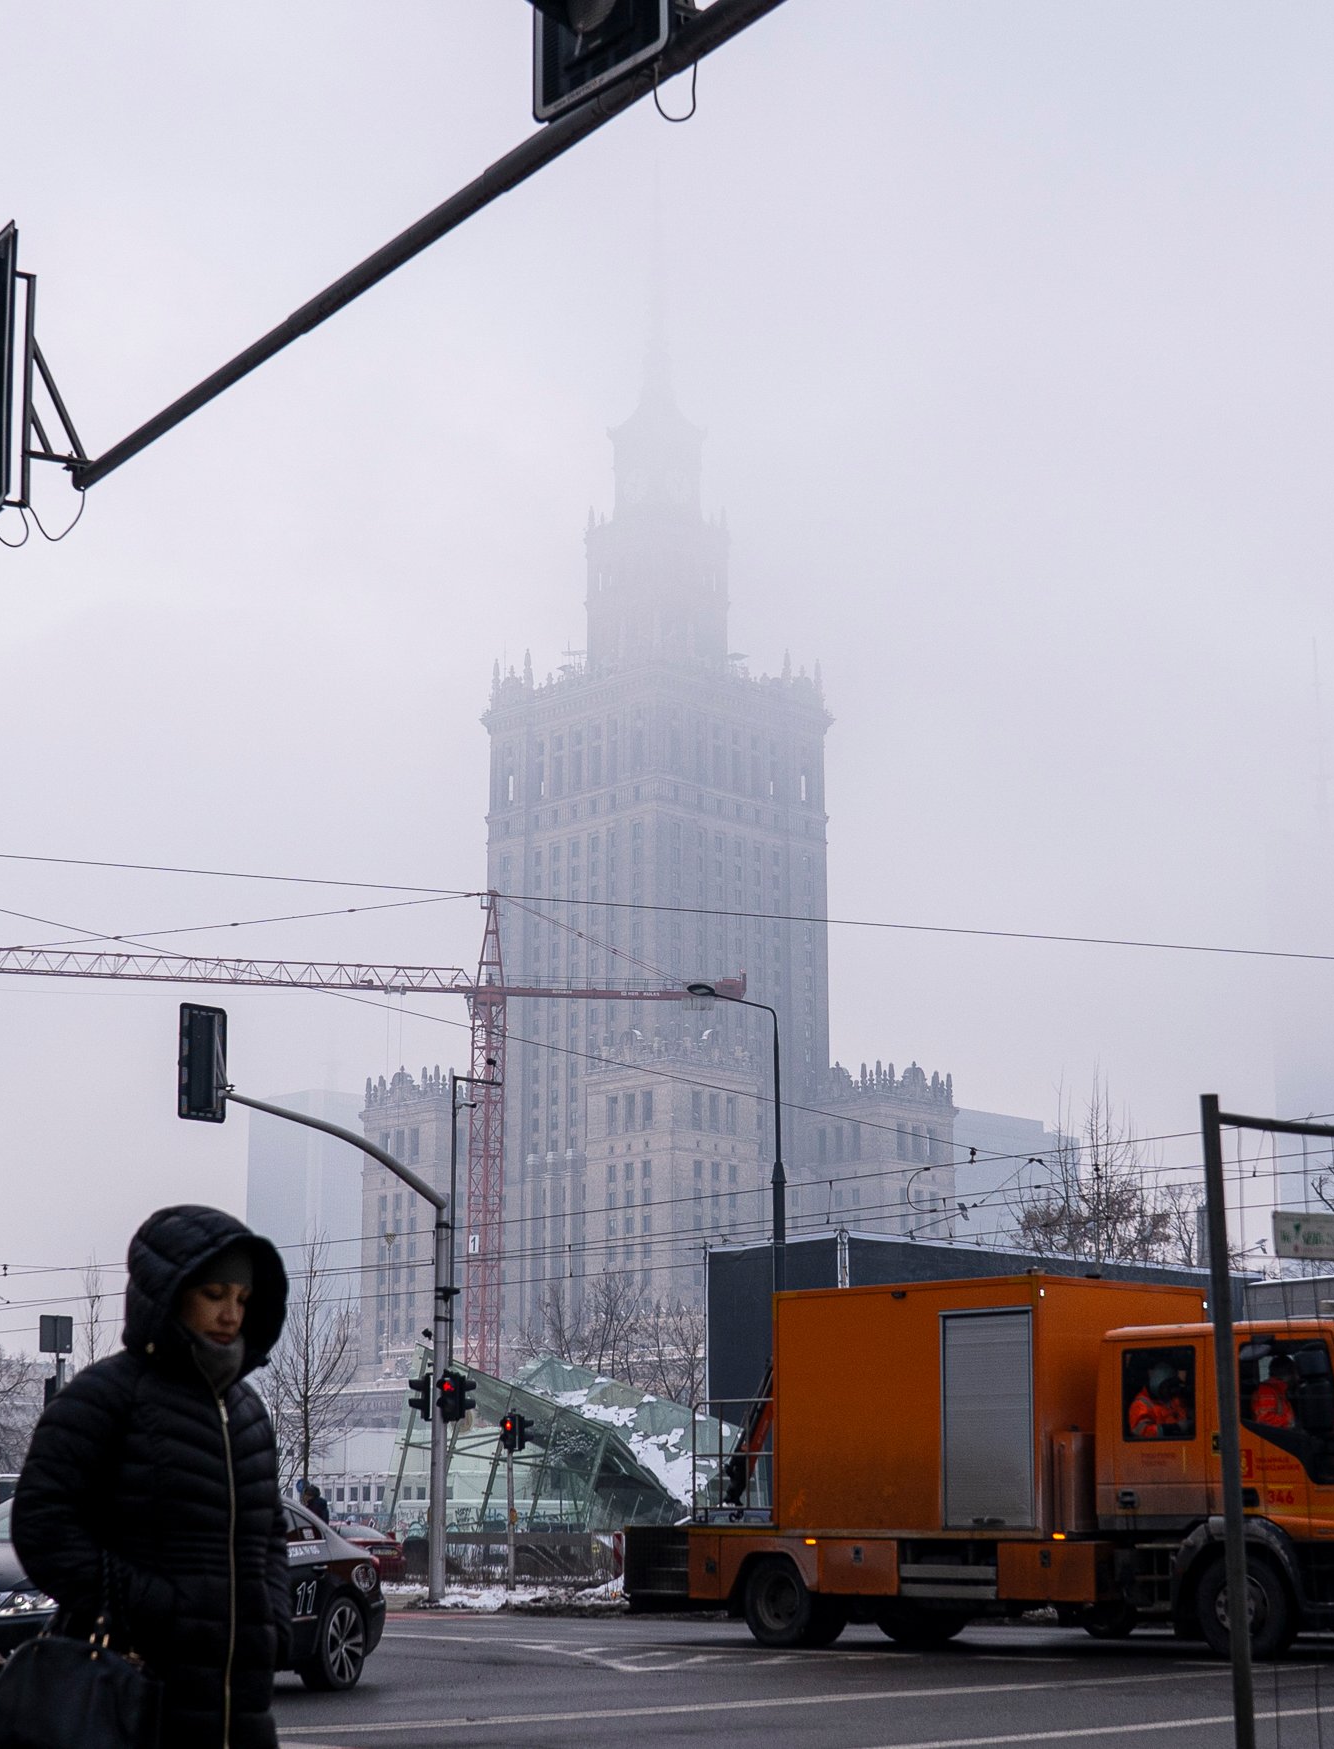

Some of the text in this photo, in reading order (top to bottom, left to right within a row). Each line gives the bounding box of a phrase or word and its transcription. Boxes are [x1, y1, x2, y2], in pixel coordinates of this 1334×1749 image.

[470, 1236, 476, 1252] 1
[1267, 1491, 1294, 1505] 346
[296, 1580, 317, 1616] 11
